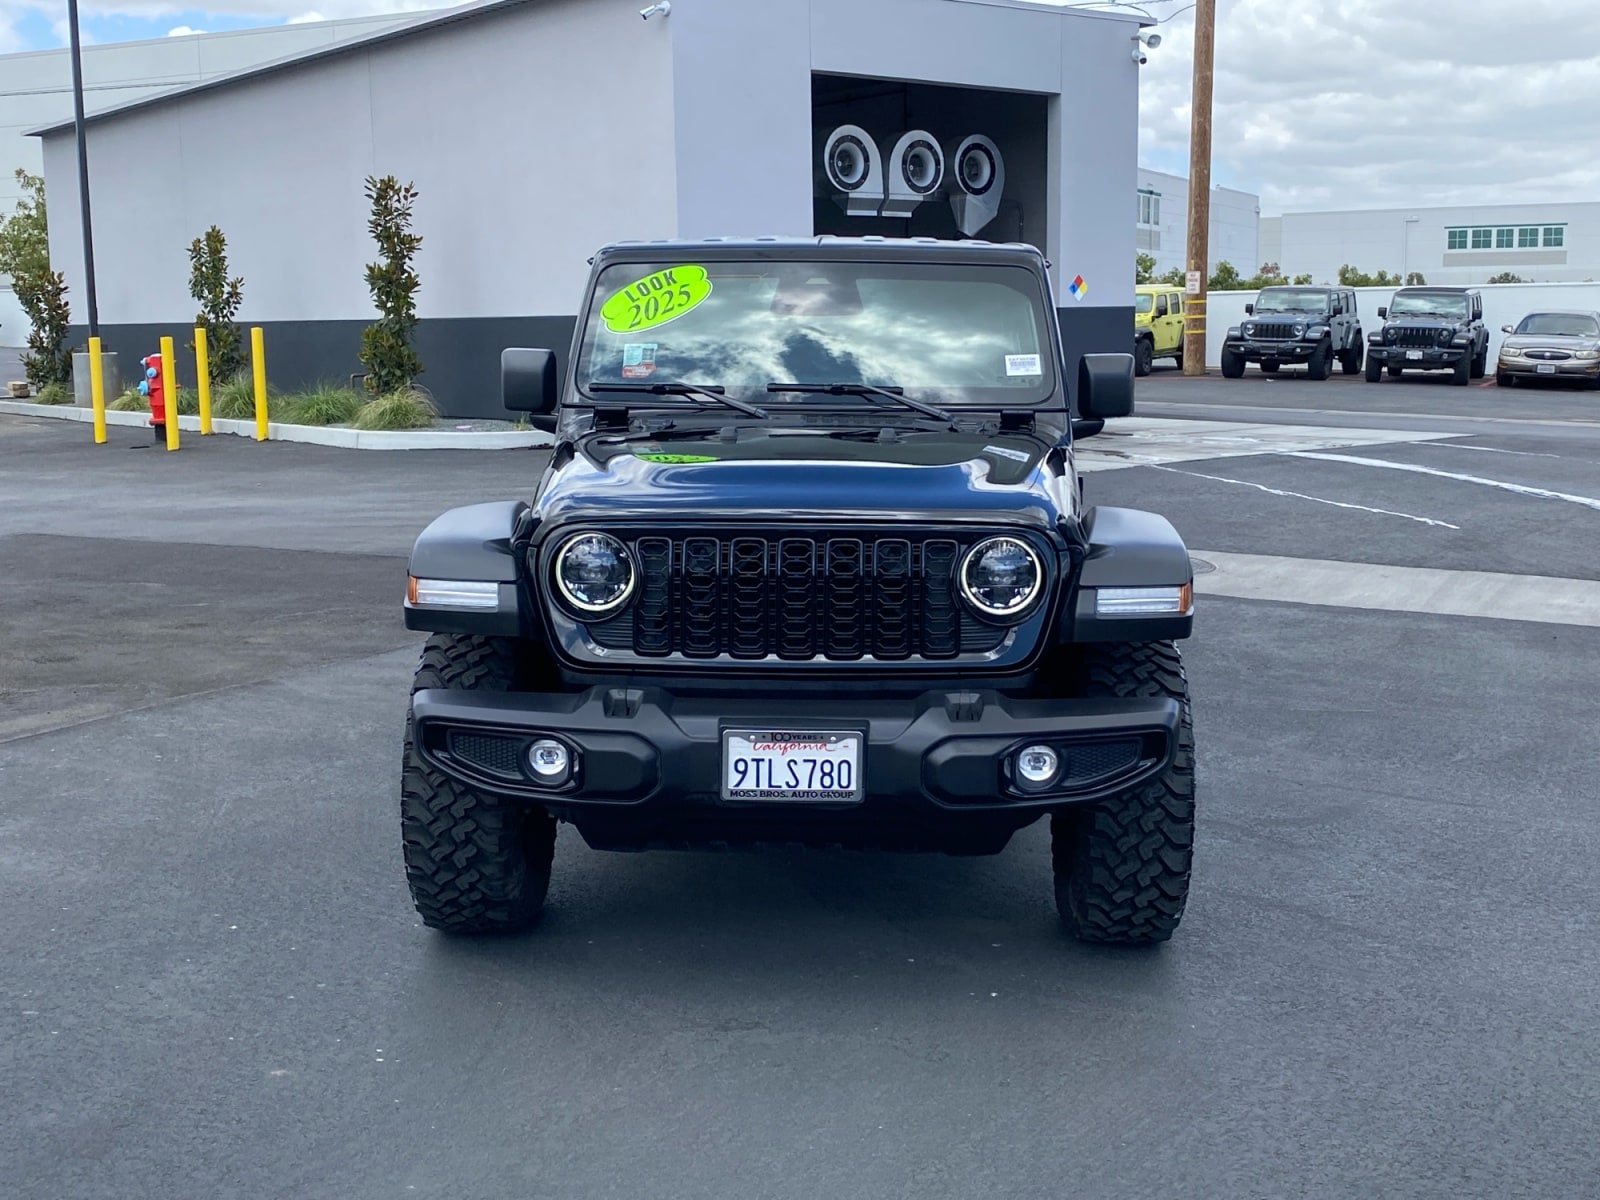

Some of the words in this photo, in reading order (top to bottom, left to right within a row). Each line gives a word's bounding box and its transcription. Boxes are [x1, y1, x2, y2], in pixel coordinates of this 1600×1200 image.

[624, 270, 677, 303] LOOK
[627, 283, 691, 329] 2025
[771, 732, 791, 742] 100
[733, 758, 851, 789] 9TLS780
[730, 790, 758, 798] MOSS
[820, 791, 854, 799] GROUP
